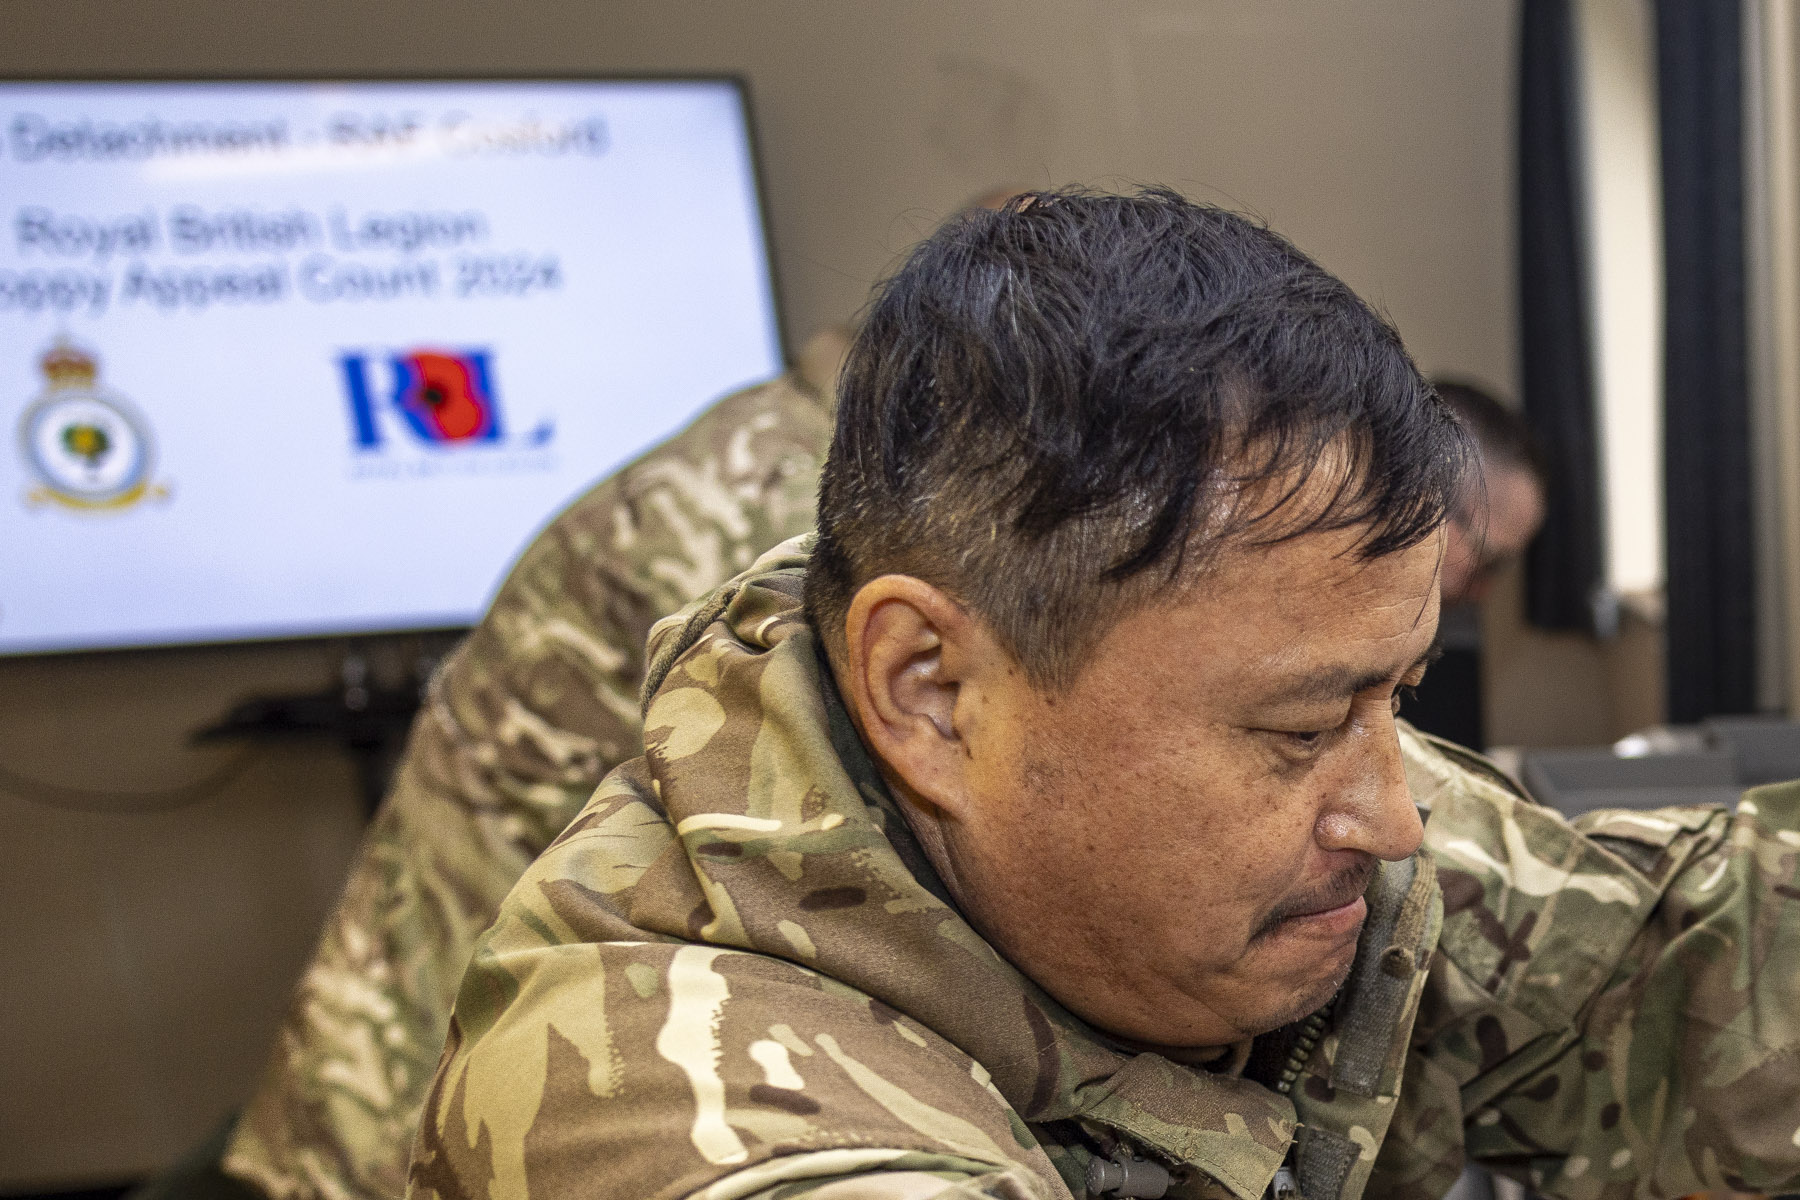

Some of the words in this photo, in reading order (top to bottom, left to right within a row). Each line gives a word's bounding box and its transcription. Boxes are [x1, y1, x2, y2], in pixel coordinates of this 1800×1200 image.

[12, 113, 290, 161] Detachment
[326, 110, 424, 150] RAF
[15, 205, 158, 261] Royal
[169, 204, 321, 252] British
[330, 204, 489, 254] Legion
[0, 270, 110, 315] oppy
[124, 259, 288, 310] Appeal
[299, 253, 441, 303] Count
[454, 250, 566, 300] 2024
